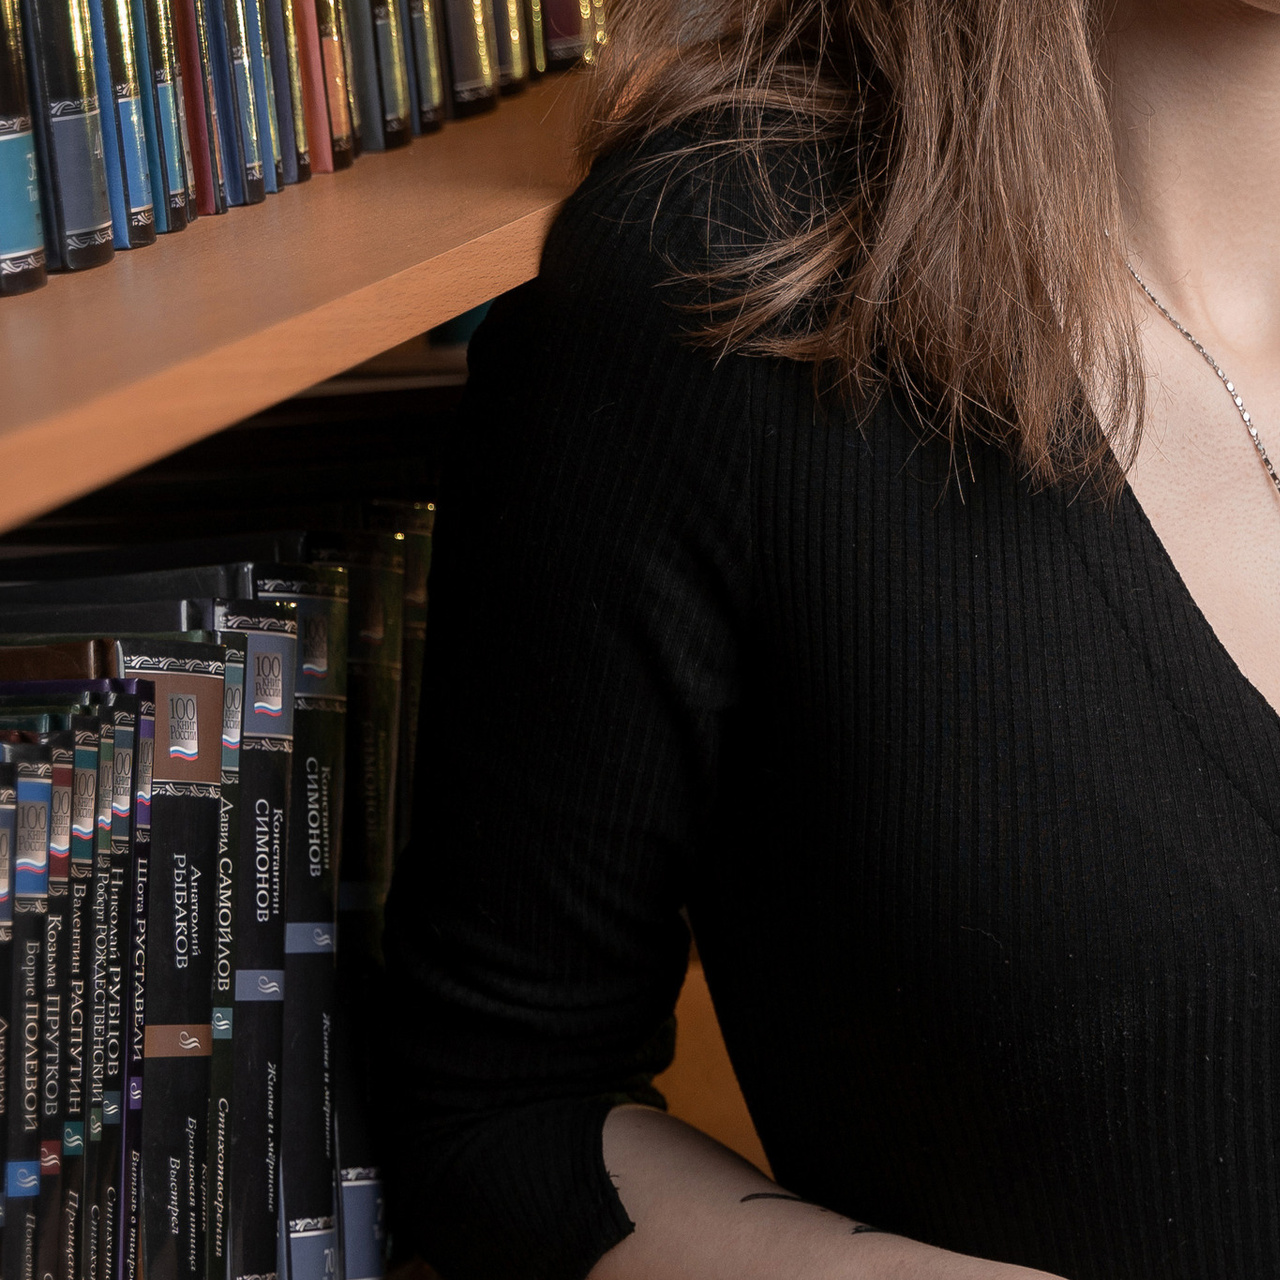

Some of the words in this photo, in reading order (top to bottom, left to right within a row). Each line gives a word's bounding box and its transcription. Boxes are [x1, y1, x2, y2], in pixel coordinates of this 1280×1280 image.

[170, 697, 195, 720] 100
[226, 687, 241, 710] 00
[256, 655, 281, 678] 100
[52, 790, 70, 815] 00
[74, 772, 95, 797] 100
[115, 752, 131, 775] 00
[20, 805, 47, 830] 100
[218, 797, 234, 855] Давид
[305, 756, 322, 877] СИМОНОВ
[320, 766, 331, 869] Константин
[92, 872, 109, 923] Роберт
[136, 857, 148, 914] Шота
[255, 798, 270, 923] СИМОНОВ
[272, 807, 284, 915] Константин
[47, 914, 62, 988] Козьма
[71, 883, 87, 973] Валентин
[109, 867, 124, 960] Николай
[173, 853, 189, 969] РЫБАКОВ
[190, 864, 202, 957] Анатолий
[217, 857, 233, 993] САМОЙЛОВ
[22, 939, 40, 996] Борис
[133, 918, 147, 1062] РУСТАВЕЛИ
[45, 994, 60, 1116] ПРУТКОВ
[69, 979, 84, 1114] РАСПУТИН
[91, 923, 108, 1103] РОЖДЕСТВЕНСКИЙ
[107, 967, 122, 1076] РУБЦОВ
[24, 1001, 39, 1133] ПОЛЕВОЙ
[267, 1061, 277, 1120] Живые
[185, 1116, 197, 1207] Бронзовая
[267, 1123, 274, 1134] и
[167, 1155, 181, 1235] Выстрел
[214, 1098, 229, 1258] Стихотворения
[265, 1138, 277, 1213] мёртвые
[188, 1211, 197, 1271] птица
